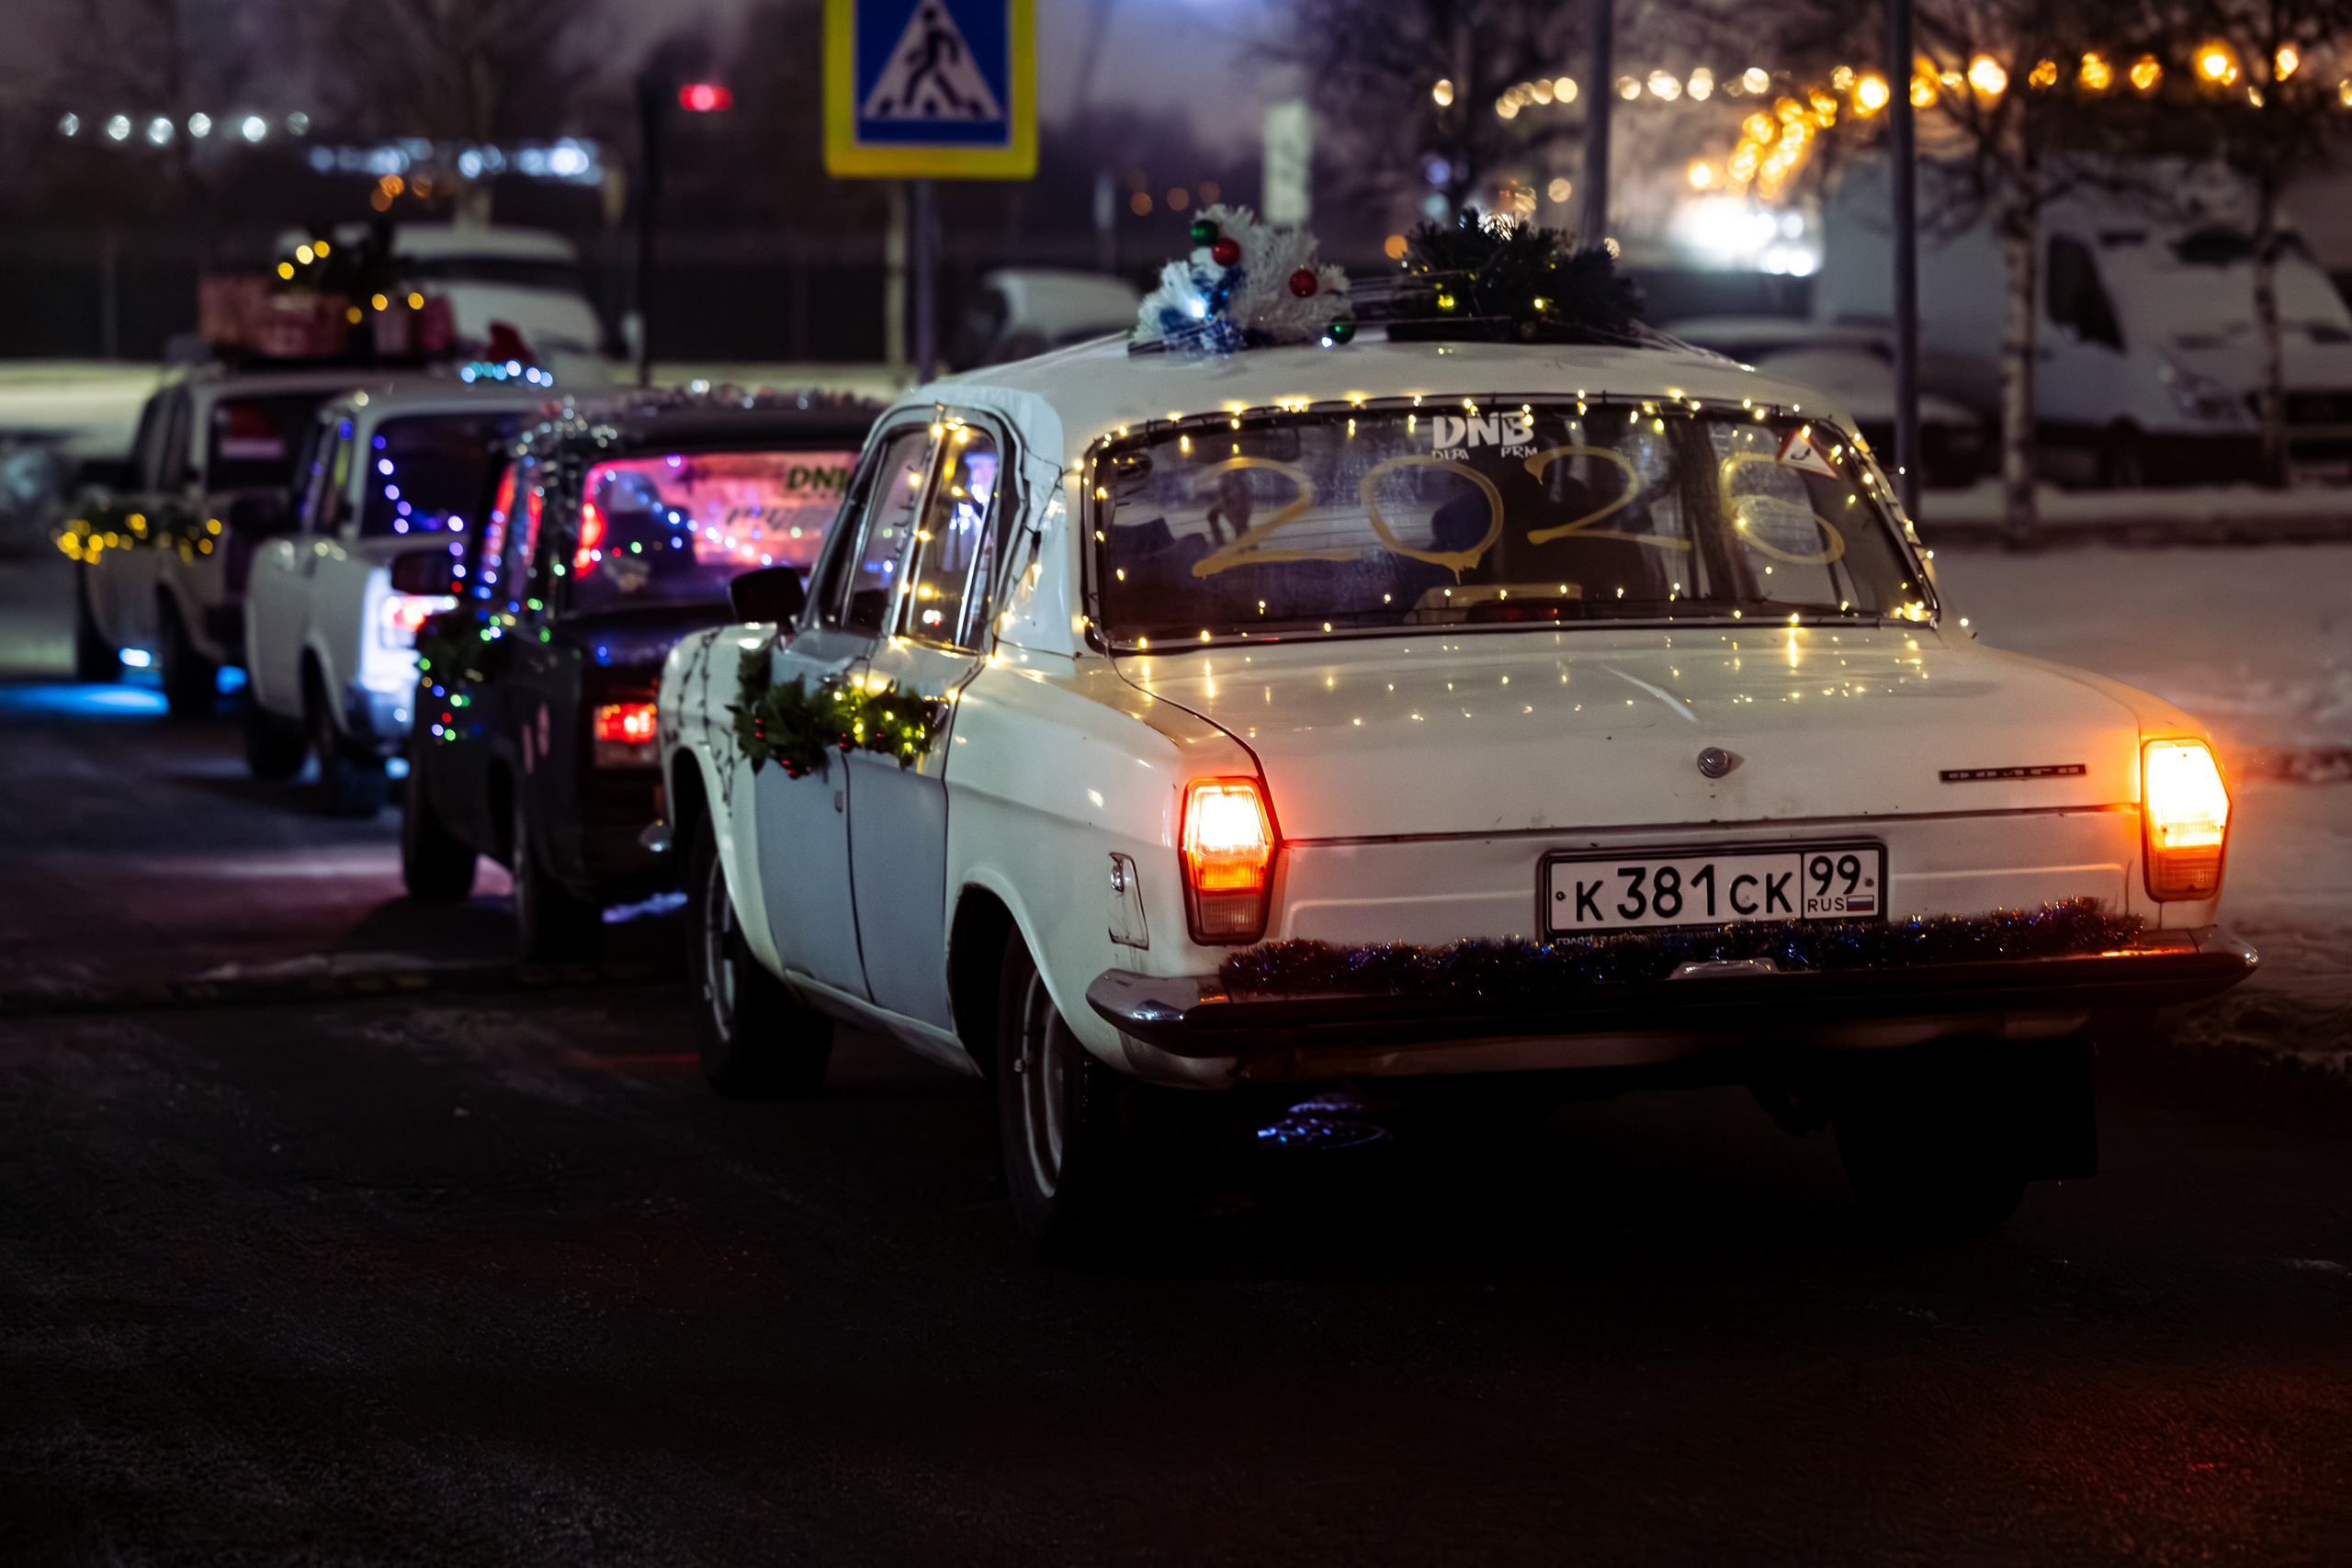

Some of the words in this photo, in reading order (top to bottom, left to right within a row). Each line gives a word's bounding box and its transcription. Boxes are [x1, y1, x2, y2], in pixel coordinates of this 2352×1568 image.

[1432, 411, 1534, 448] DNB
[1192, 446, 1844, 582] 2026
[1809, 854, 1861, 897] 99
[1806, 897, 1845, 912] RUS
